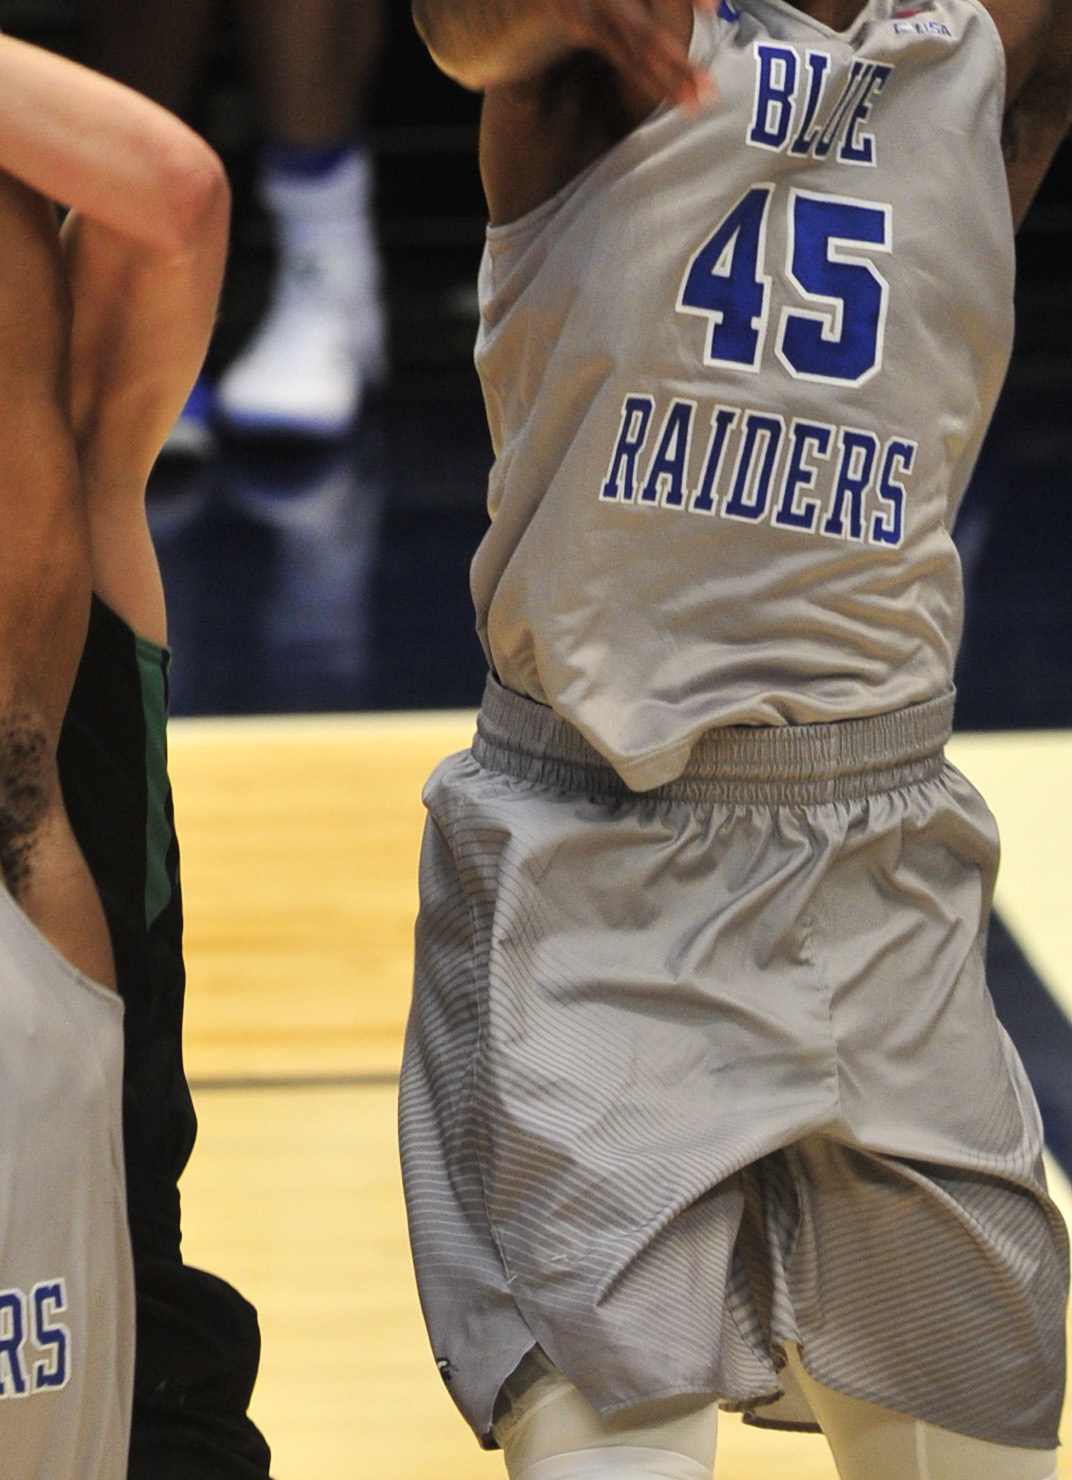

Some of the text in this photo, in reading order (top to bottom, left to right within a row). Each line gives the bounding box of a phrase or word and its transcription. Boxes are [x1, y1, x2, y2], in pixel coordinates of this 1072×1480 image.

[746, 41, 895, 168] BLUE
[675, 182, 893, 388] 45
[600, 393, 918, 549] RAIDERS
